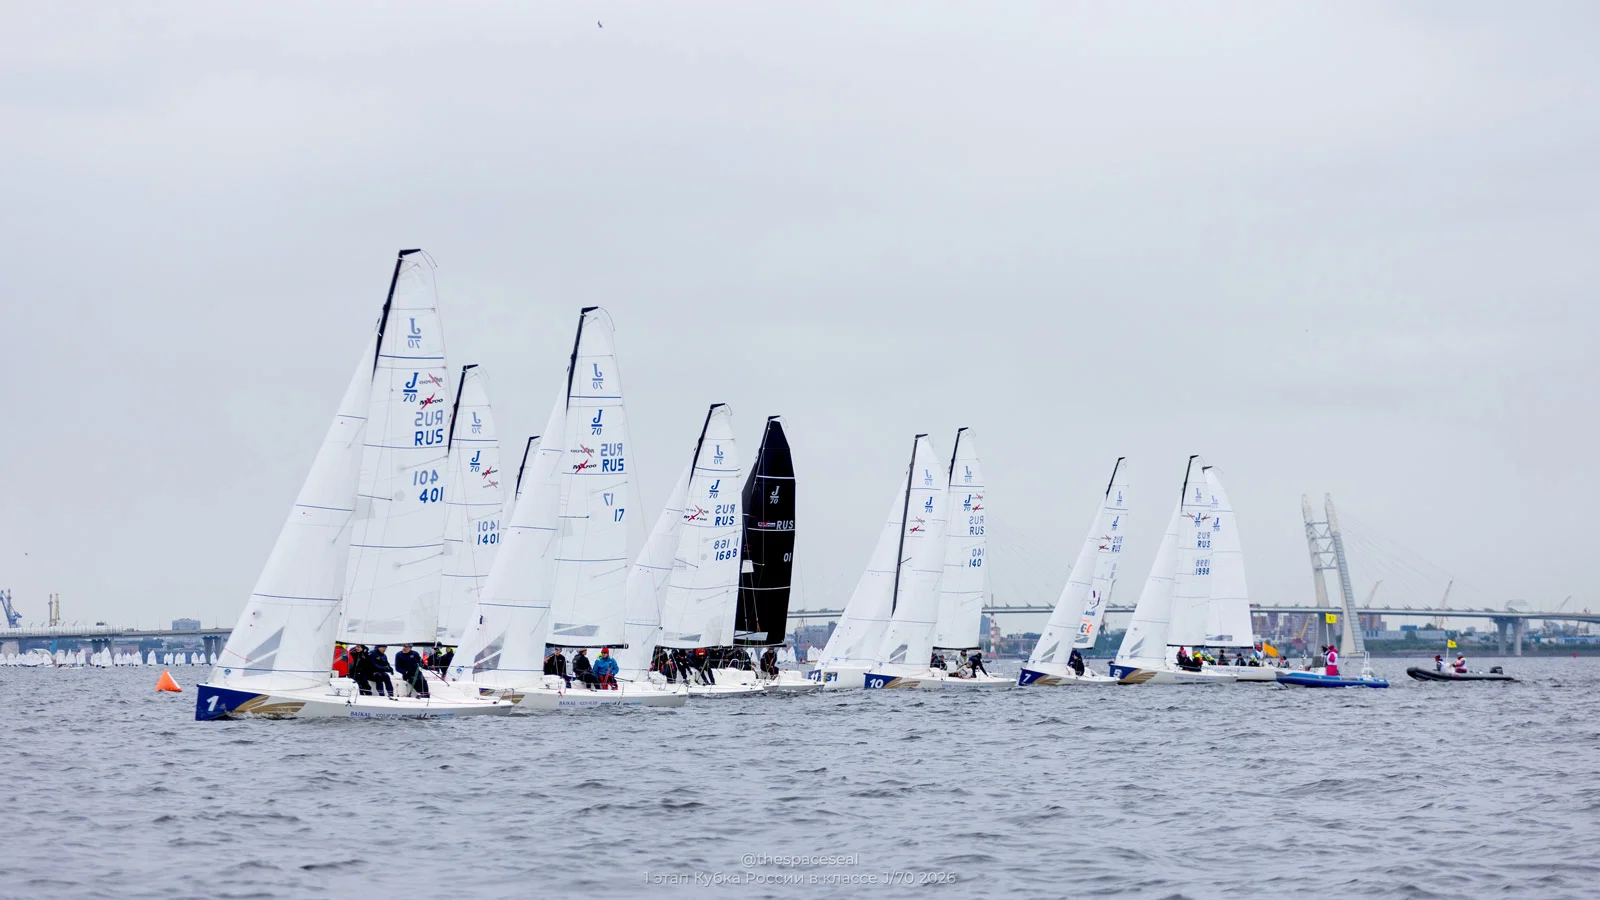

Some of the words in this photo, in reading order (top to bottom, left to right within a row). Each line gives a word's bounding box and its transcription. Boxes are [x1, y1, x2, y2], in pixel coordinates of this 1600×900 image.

[405, 372, 419, 388] J
[403, 393, 416, 402] 70
[592, 410, 603, 424] J
[591, 427, 602, 436] 70
[415, 429, 443, 446] RUS
[472, 451, 480, 462] J
[602, 458, 624, 472] RUS
[711, 480, 720, 489] J
[419, 487, 444, 503] 401
[772, 486, 779, 496] J
[614, 508, 625, 522] 17
[715, 516, 734, 526] RUS
[776, 520, 793, 529] RUS
[970, 526, 984, 535] RUS
[477, 533, 500, 545] 1401
[716, 548, 737, 561] 1688
[969, 558, 982, 567] 140
[811, 672, 819, 681] 11
[826, 672, 838, 681] 31
[1023, 673, 1031, 683] 7
[870, 679, 884, 688] 10
[206, 695, 219, 711] 1
